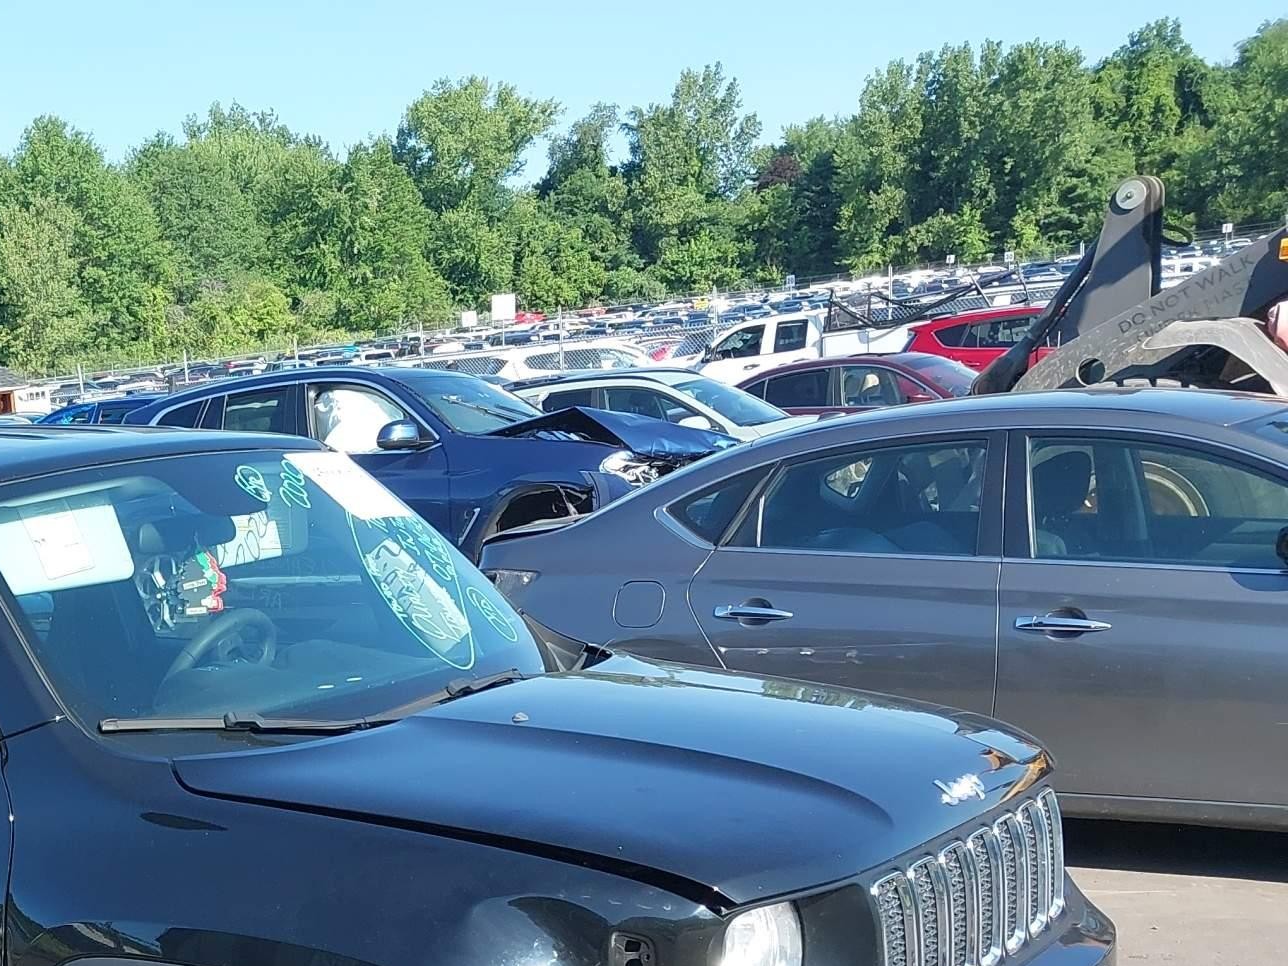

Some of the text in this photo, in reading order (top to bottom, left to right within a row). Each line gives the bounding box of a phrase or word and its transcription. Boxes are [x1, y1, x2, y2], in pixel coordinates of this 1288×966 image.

[1118, 312, 1145, 334] DO
[1150, 286, 1190, 316] NOT
[1195, 254, 1255, 290] WALK
